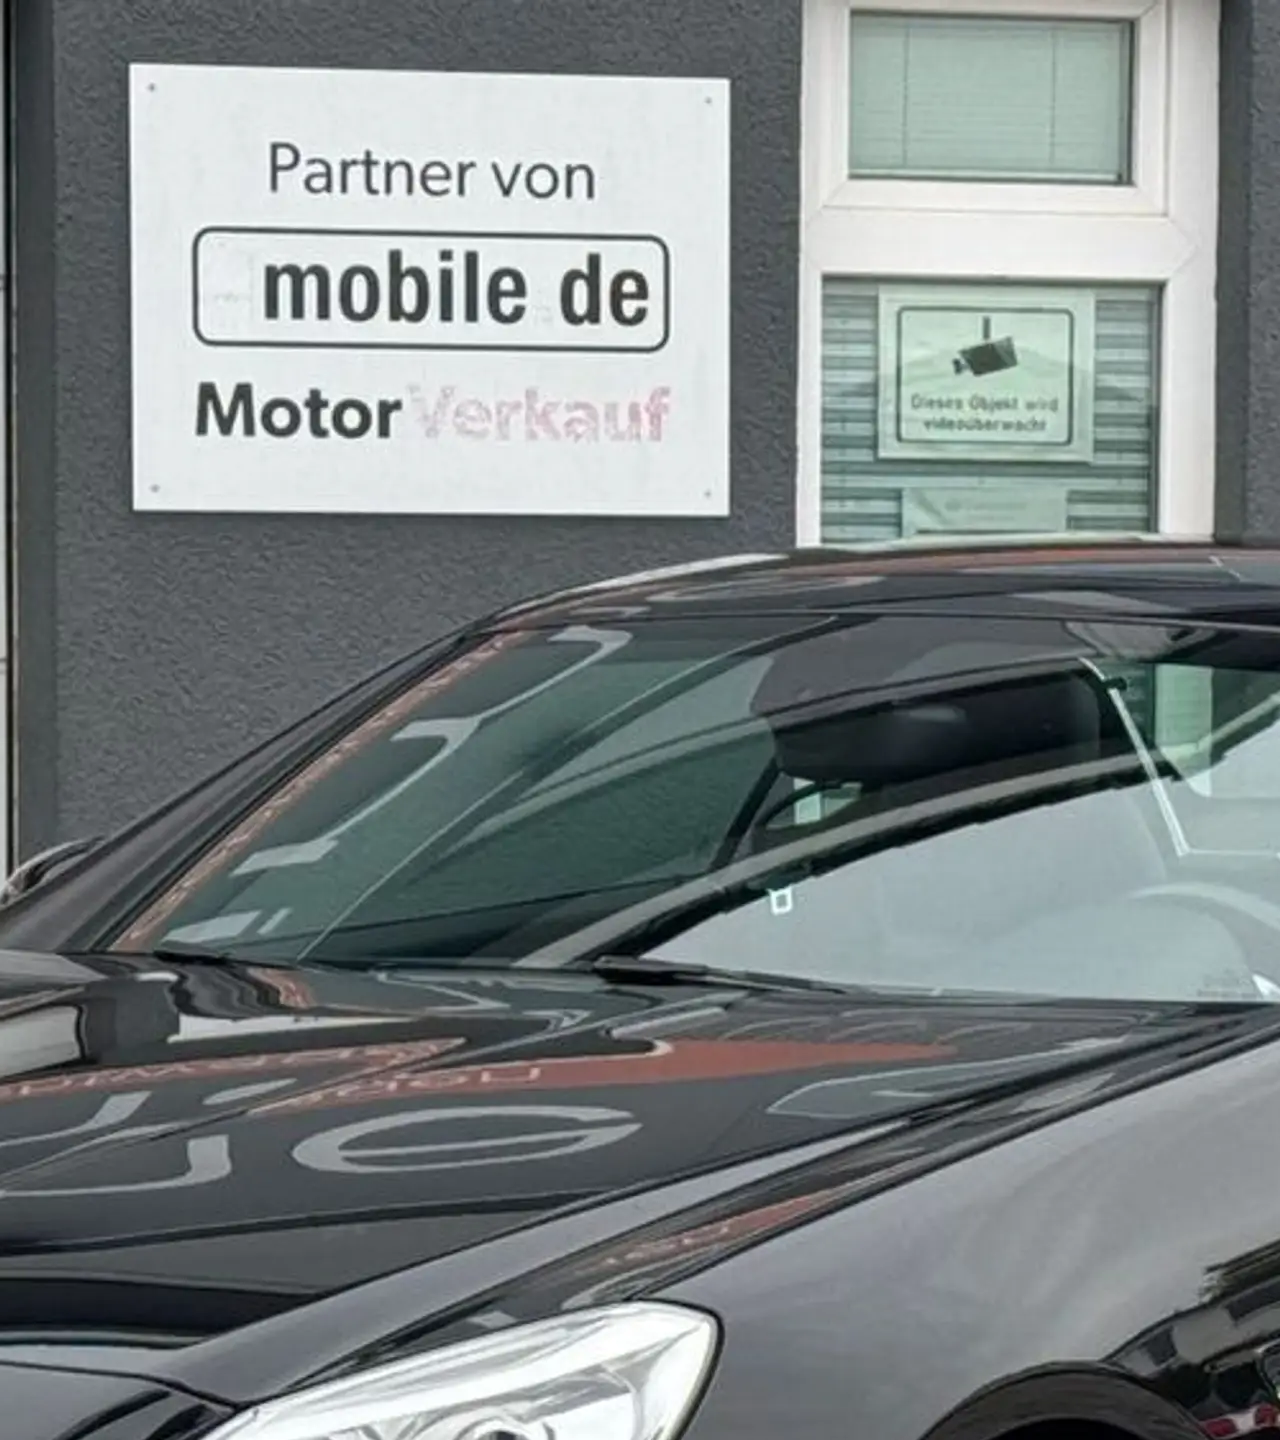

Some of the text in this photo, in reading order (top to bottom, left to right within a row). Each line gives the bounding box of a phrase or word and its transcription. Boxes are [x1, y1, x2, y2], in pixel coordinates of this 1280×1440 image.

[270, 142, 596, 201] Partner von
[264, 249, 650, 328] mobile de
